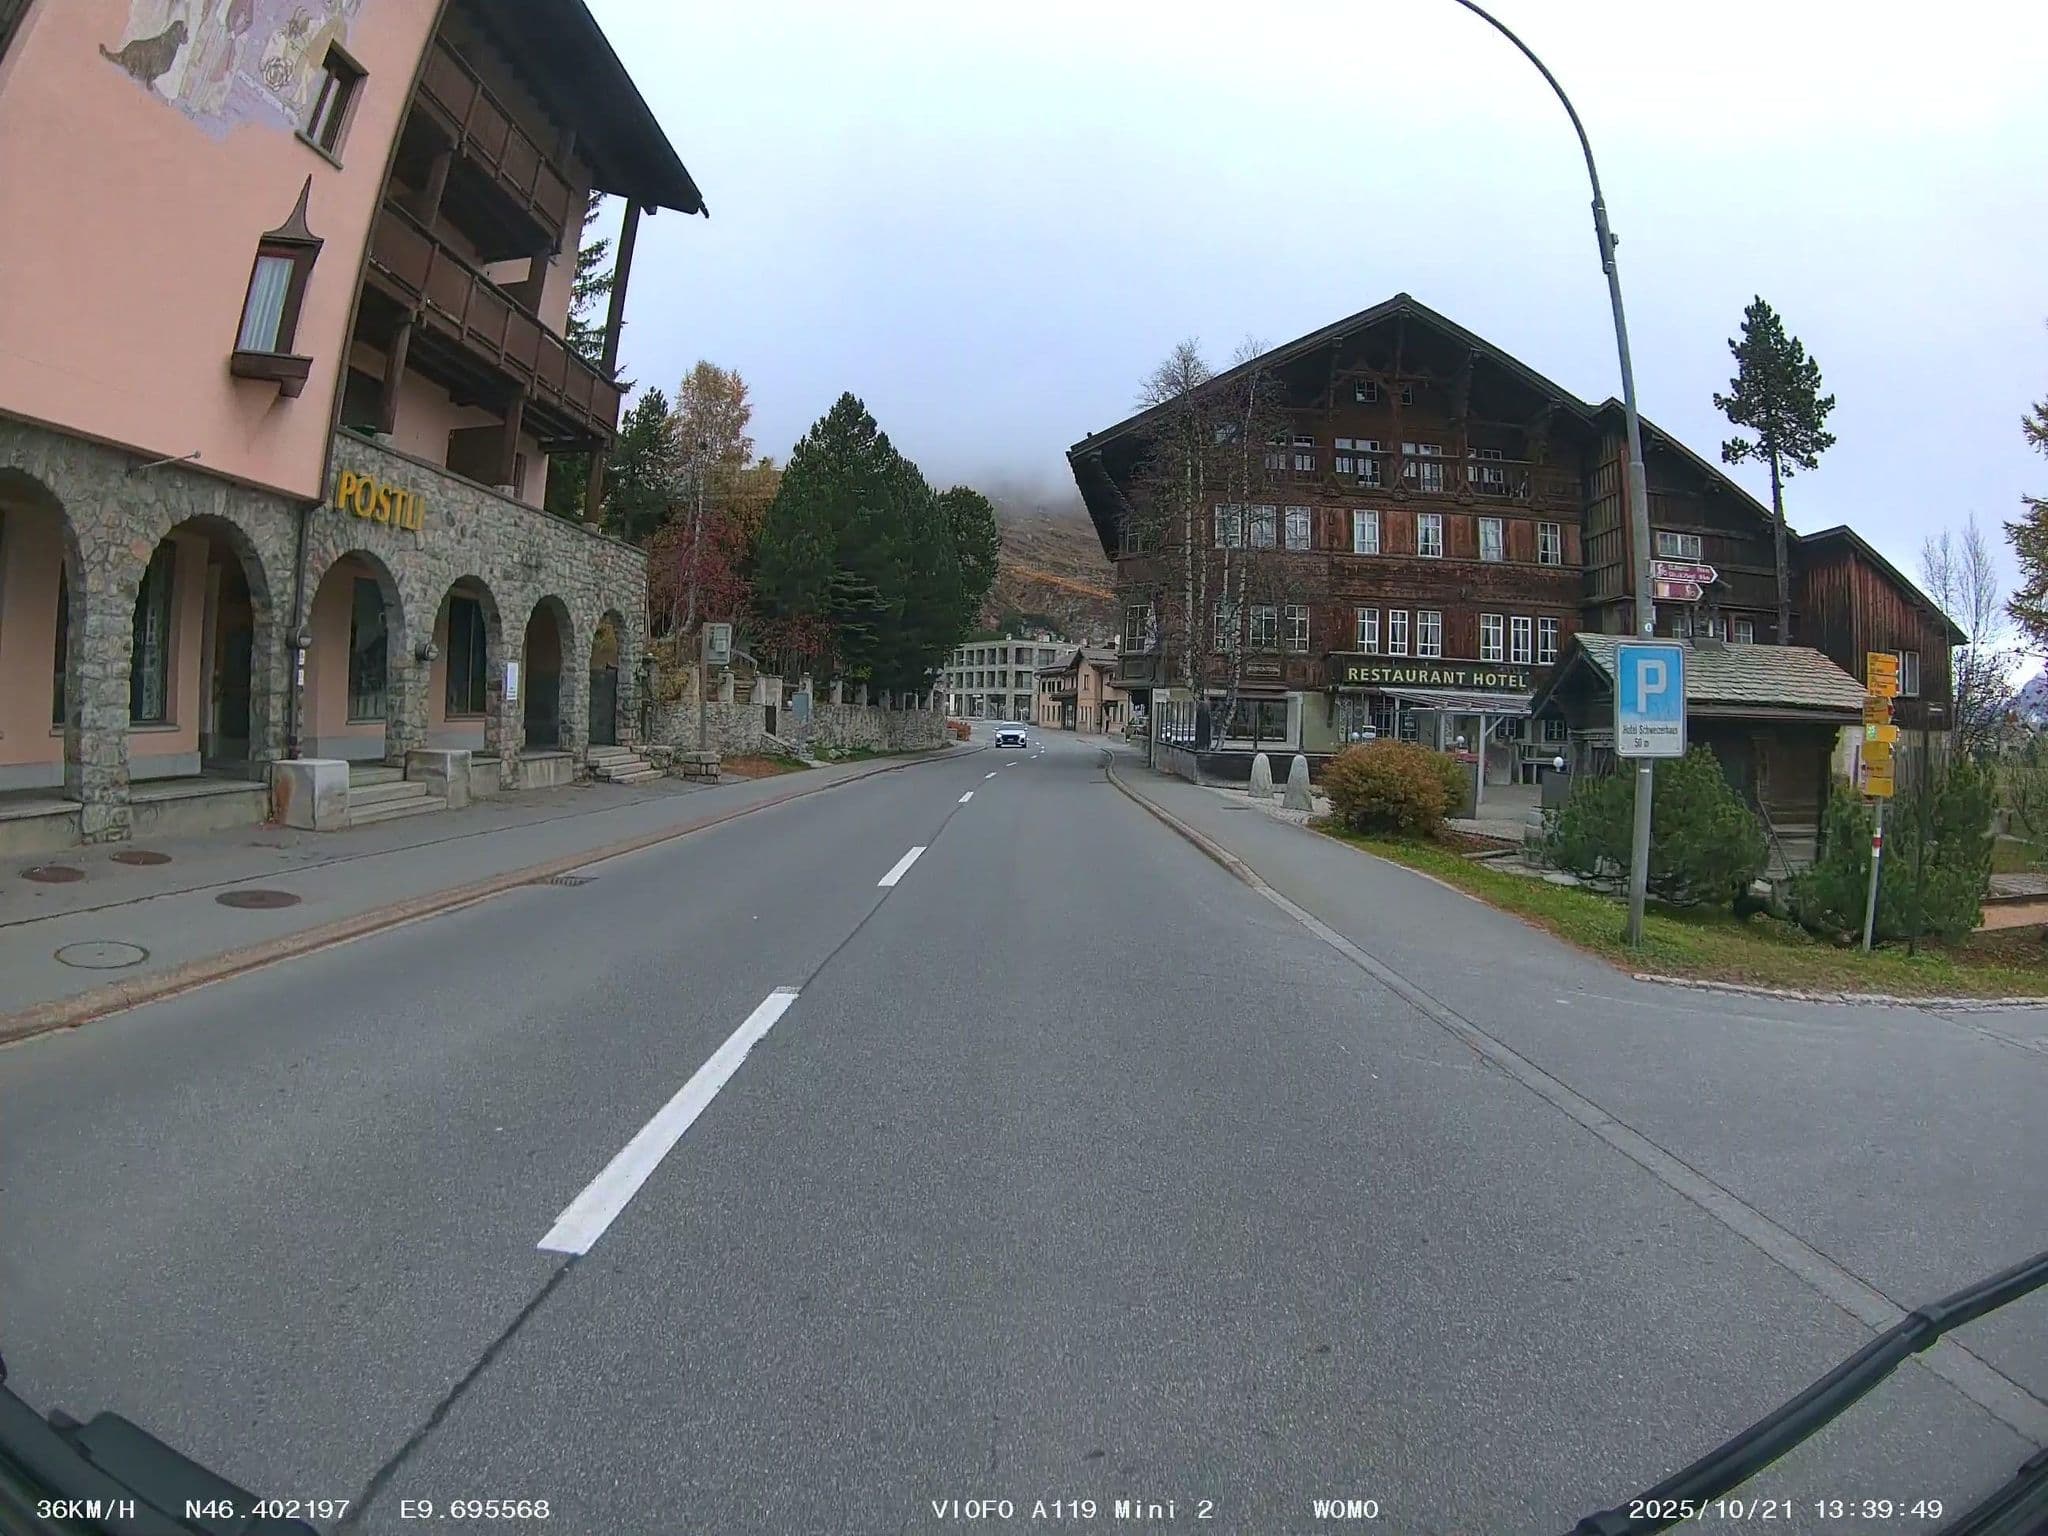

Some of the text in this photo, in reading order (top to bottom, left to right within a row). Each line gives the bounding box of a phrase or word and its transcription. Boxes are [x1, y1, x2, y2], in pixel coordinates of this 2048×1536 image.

[1348, 667, 1527, 688] RESTAURANT HOTEL
[1637, 659, 1667, 713] P
